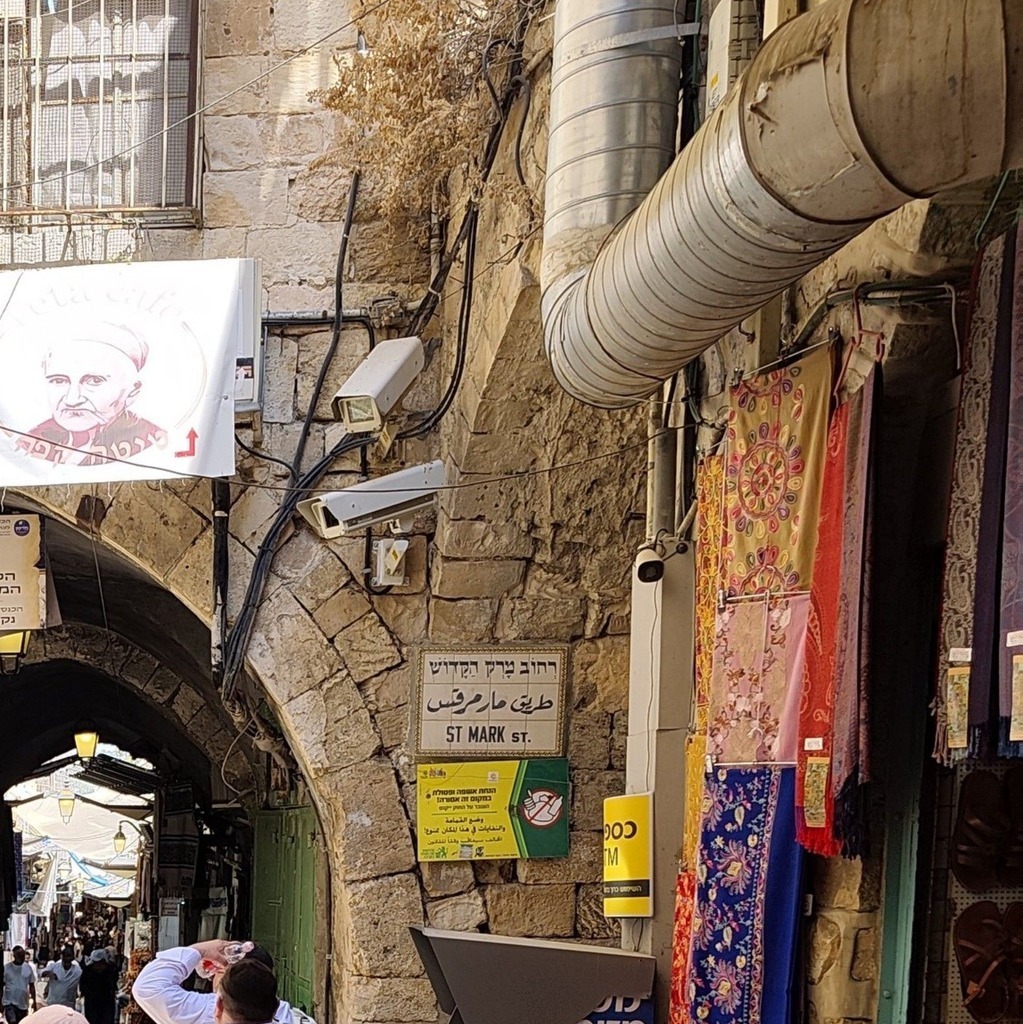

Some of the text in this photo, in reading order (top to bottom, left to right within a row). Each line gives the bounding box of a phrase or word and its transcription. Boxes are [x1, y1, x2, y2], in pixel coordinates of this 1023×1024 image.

[510, 693, 554, 714] طريق
[446, 726, 531, 743] ST MARK ST.
